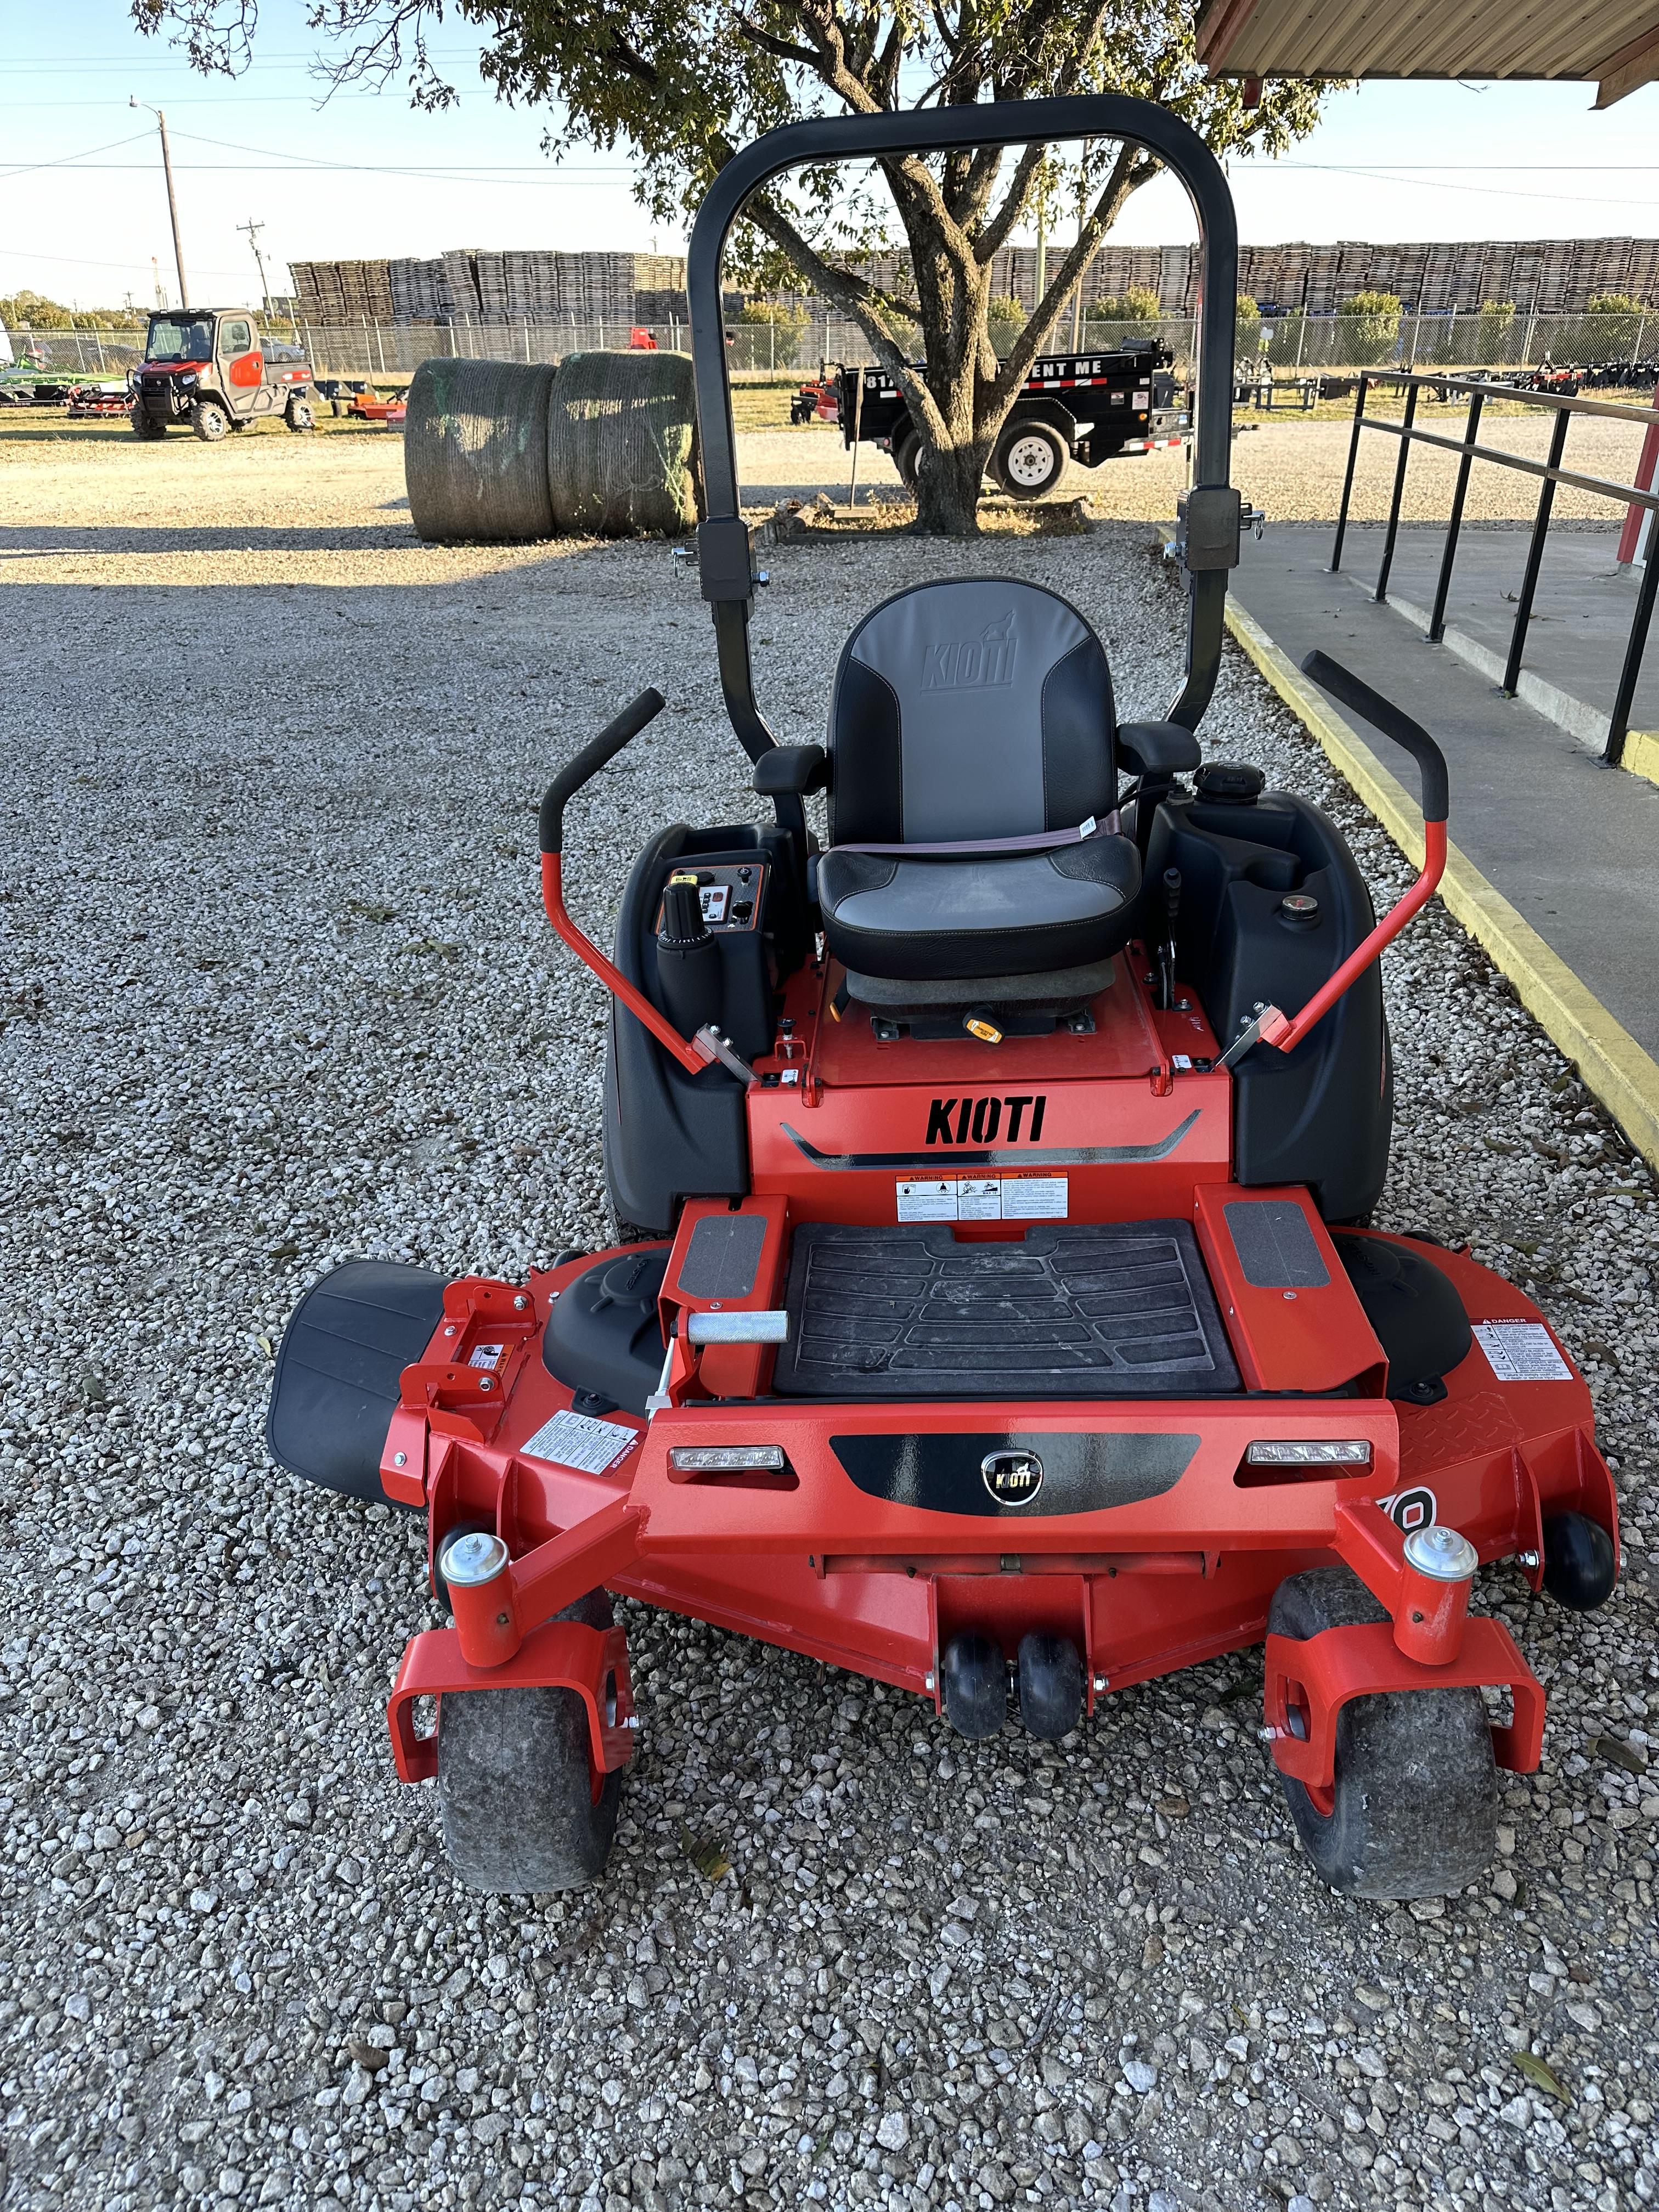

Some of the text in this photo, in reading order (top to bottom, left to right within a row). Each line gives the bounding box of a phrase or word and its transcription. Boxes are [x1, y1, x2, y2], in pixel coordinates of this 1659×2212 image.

[1032, 360, 1101, 377] ENT ME
[921, 639, 1018, 688] KIOTI
[925, 1096, 1047, 1145] KIOTI
[610, 1446, 634, 1468] DANGER
[996, 1471, 1031, 1489] KIOTI
[1375, 1486, 1437, 1536] 0
